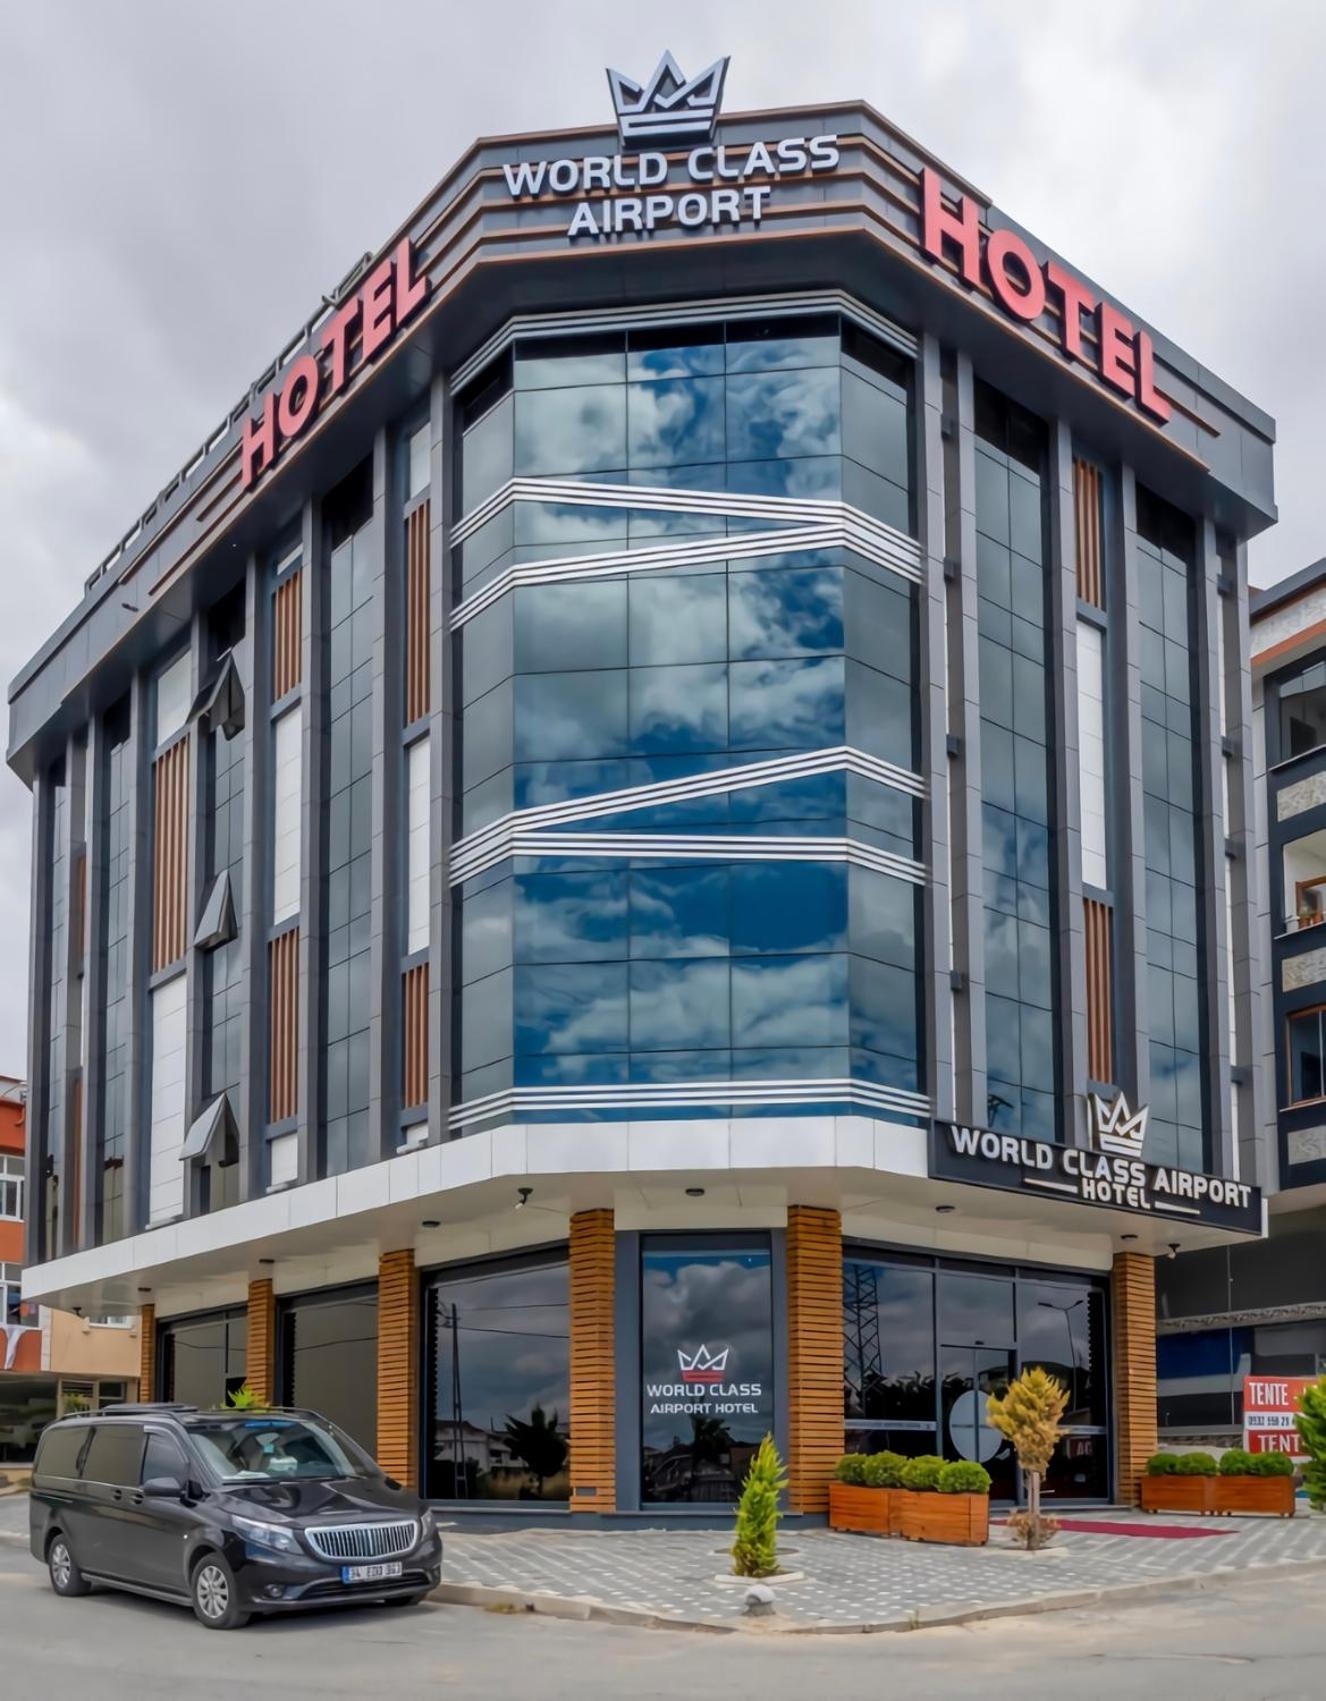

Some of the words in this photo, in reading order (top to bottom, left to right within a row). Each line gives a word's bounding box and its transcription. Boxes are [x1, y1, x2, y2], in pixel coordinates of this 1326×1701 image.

[503, 151, 668, 198] WORLD
[688, 134, 840, 182] CLASS
[567, 185, 771, 237] AIRPORT
[921, 166, 1173, 425] HOTEL
[241, 236, 431, 492] HOTEL
[951, 1124, 1053, 1170] WORLD
[1063, 1149, 1147, 1187] CLASS
[1153, 1166, 1252, 1209] AIRPORT
[1082, 1177, 1151, 1210] HOTEL
[646, 1384, 705, 1397] WORLD
[709, 1383, 762, 1396] CLASS
[650, 1403, 712, 1414] AIRPORT
[715, 1402, 759, 1414] HOTEL
[1248, 1382, 1289, 1406] TENTE
